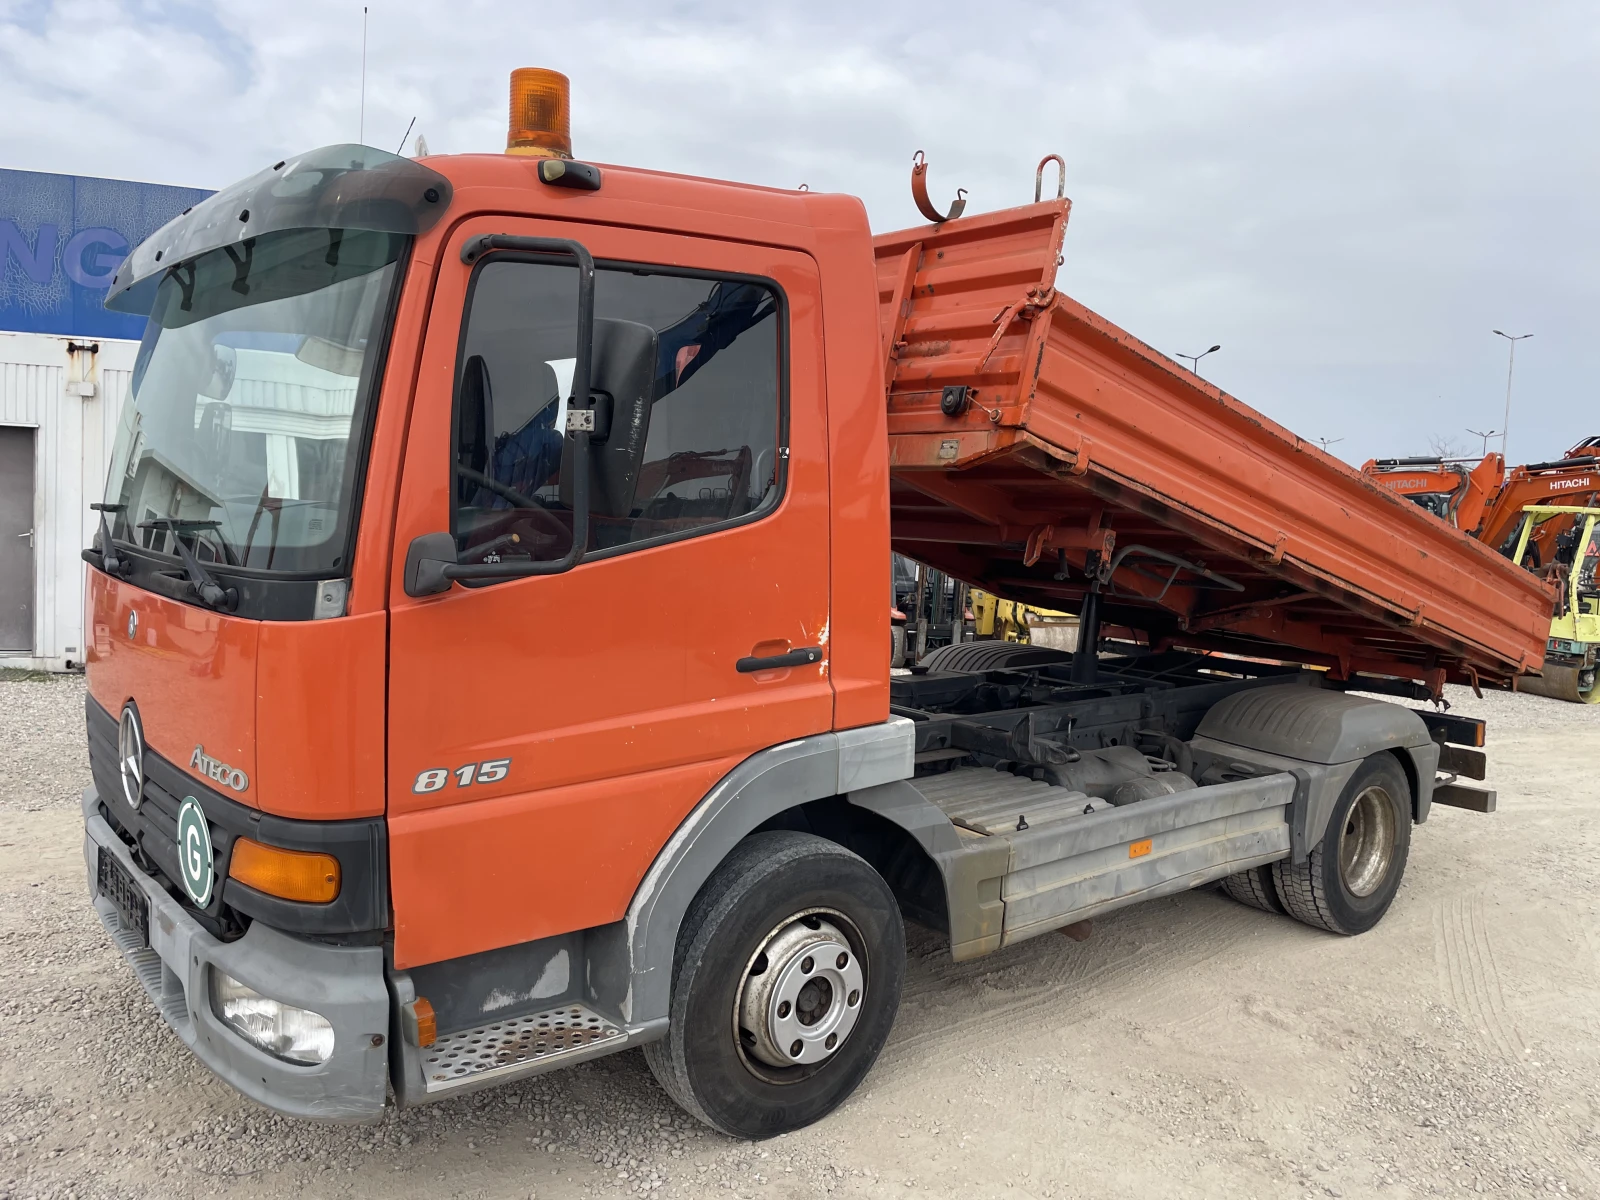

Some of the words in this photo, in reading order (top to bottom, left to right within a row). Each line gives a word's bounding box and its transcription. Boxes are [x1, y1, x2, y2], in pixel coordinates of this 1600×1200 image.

[1385, 478, 1428, 490] HITACHI
[1550, 477, 1590, 490] HITACHI
[412, 757, 512, 794] 815
[187, 824, 201, 881] G
